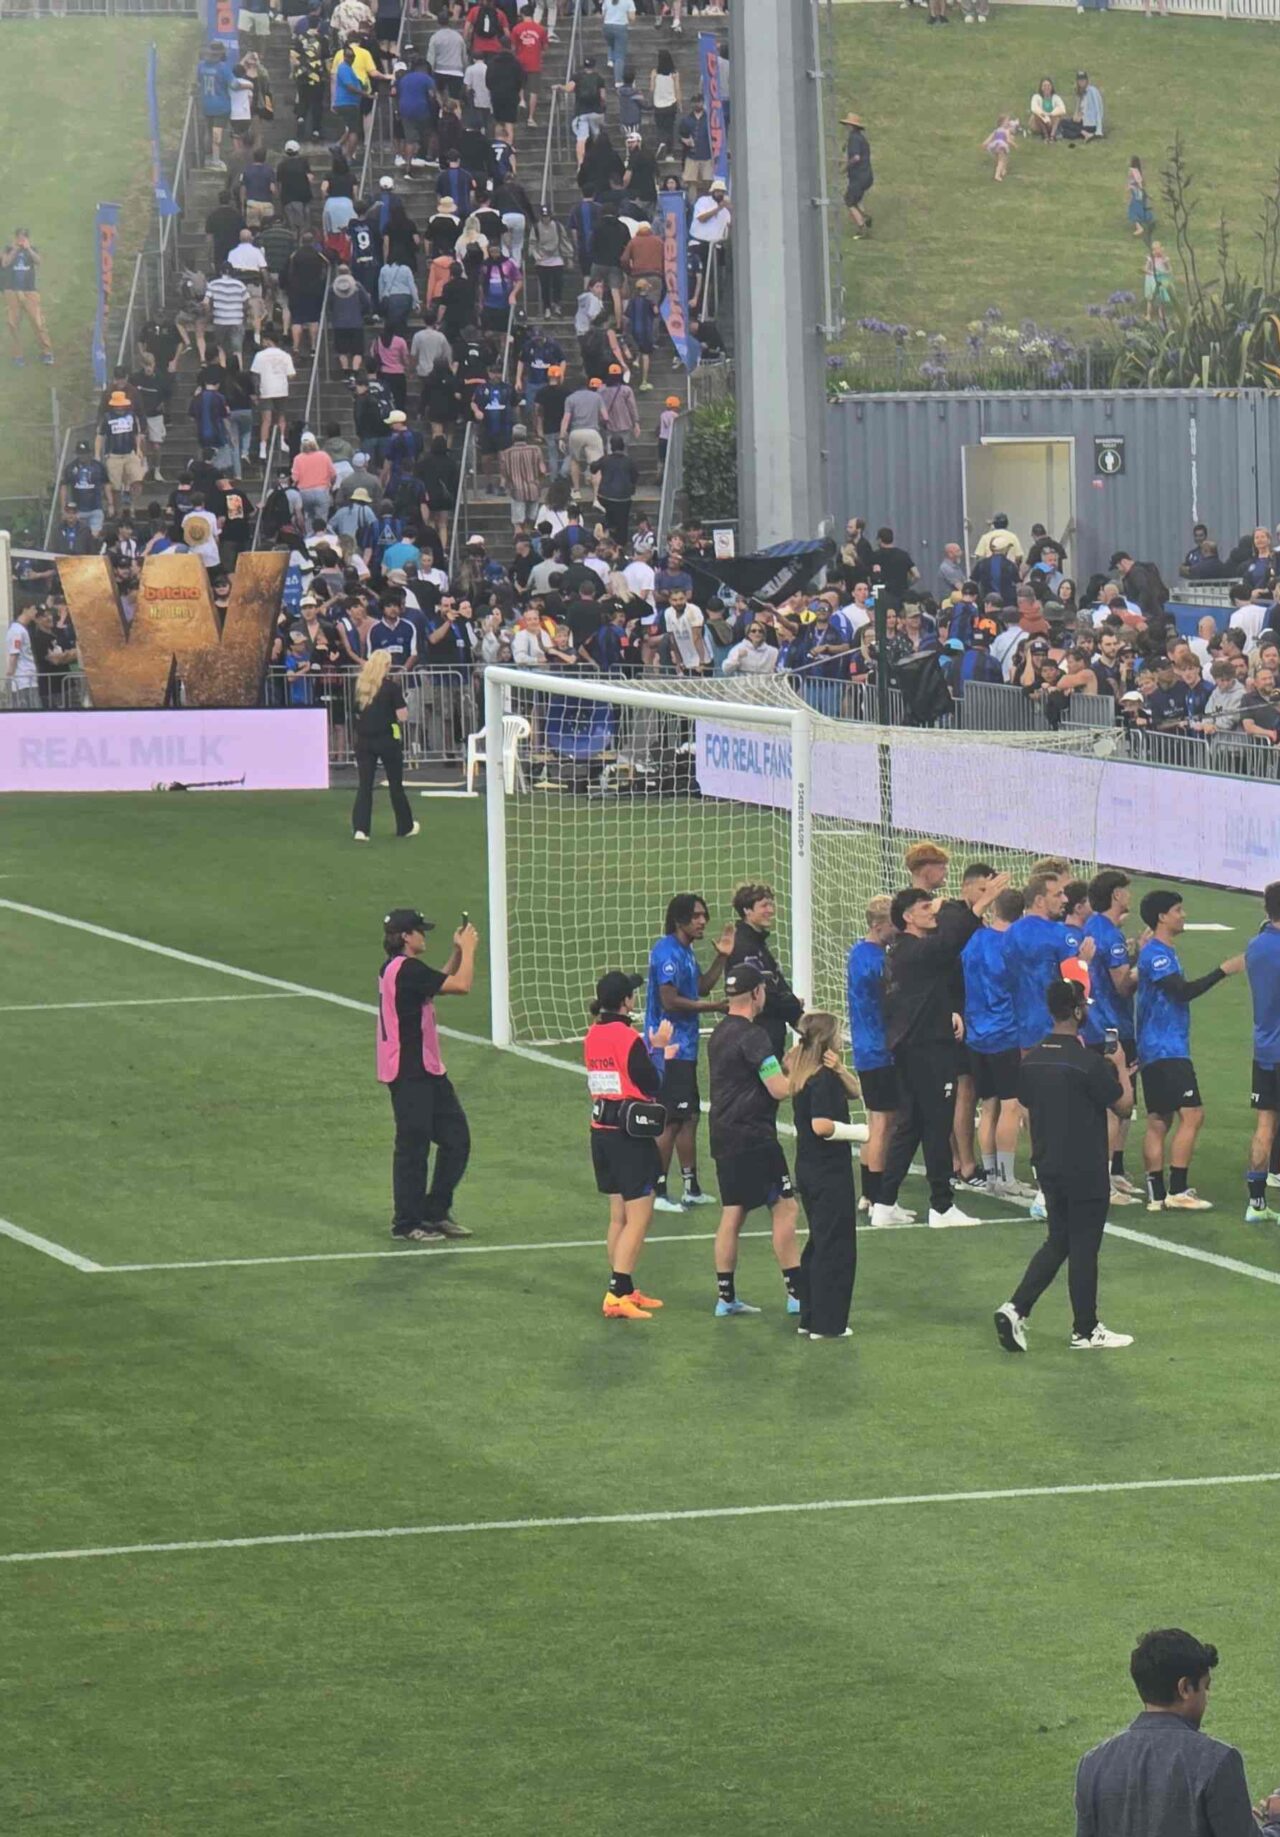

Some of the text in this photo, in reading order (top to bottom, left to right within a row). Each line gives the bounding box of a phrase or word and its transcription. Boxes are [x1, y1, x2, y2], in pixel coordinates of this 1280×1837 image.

[357, 231, 370, 250] 9
[144, 585, 200, 602] betcha
[19, 734, 225, 768] REAL MILK
[705, 733, 730, 770] FOR
[732, 737, 763, 775] REAL
